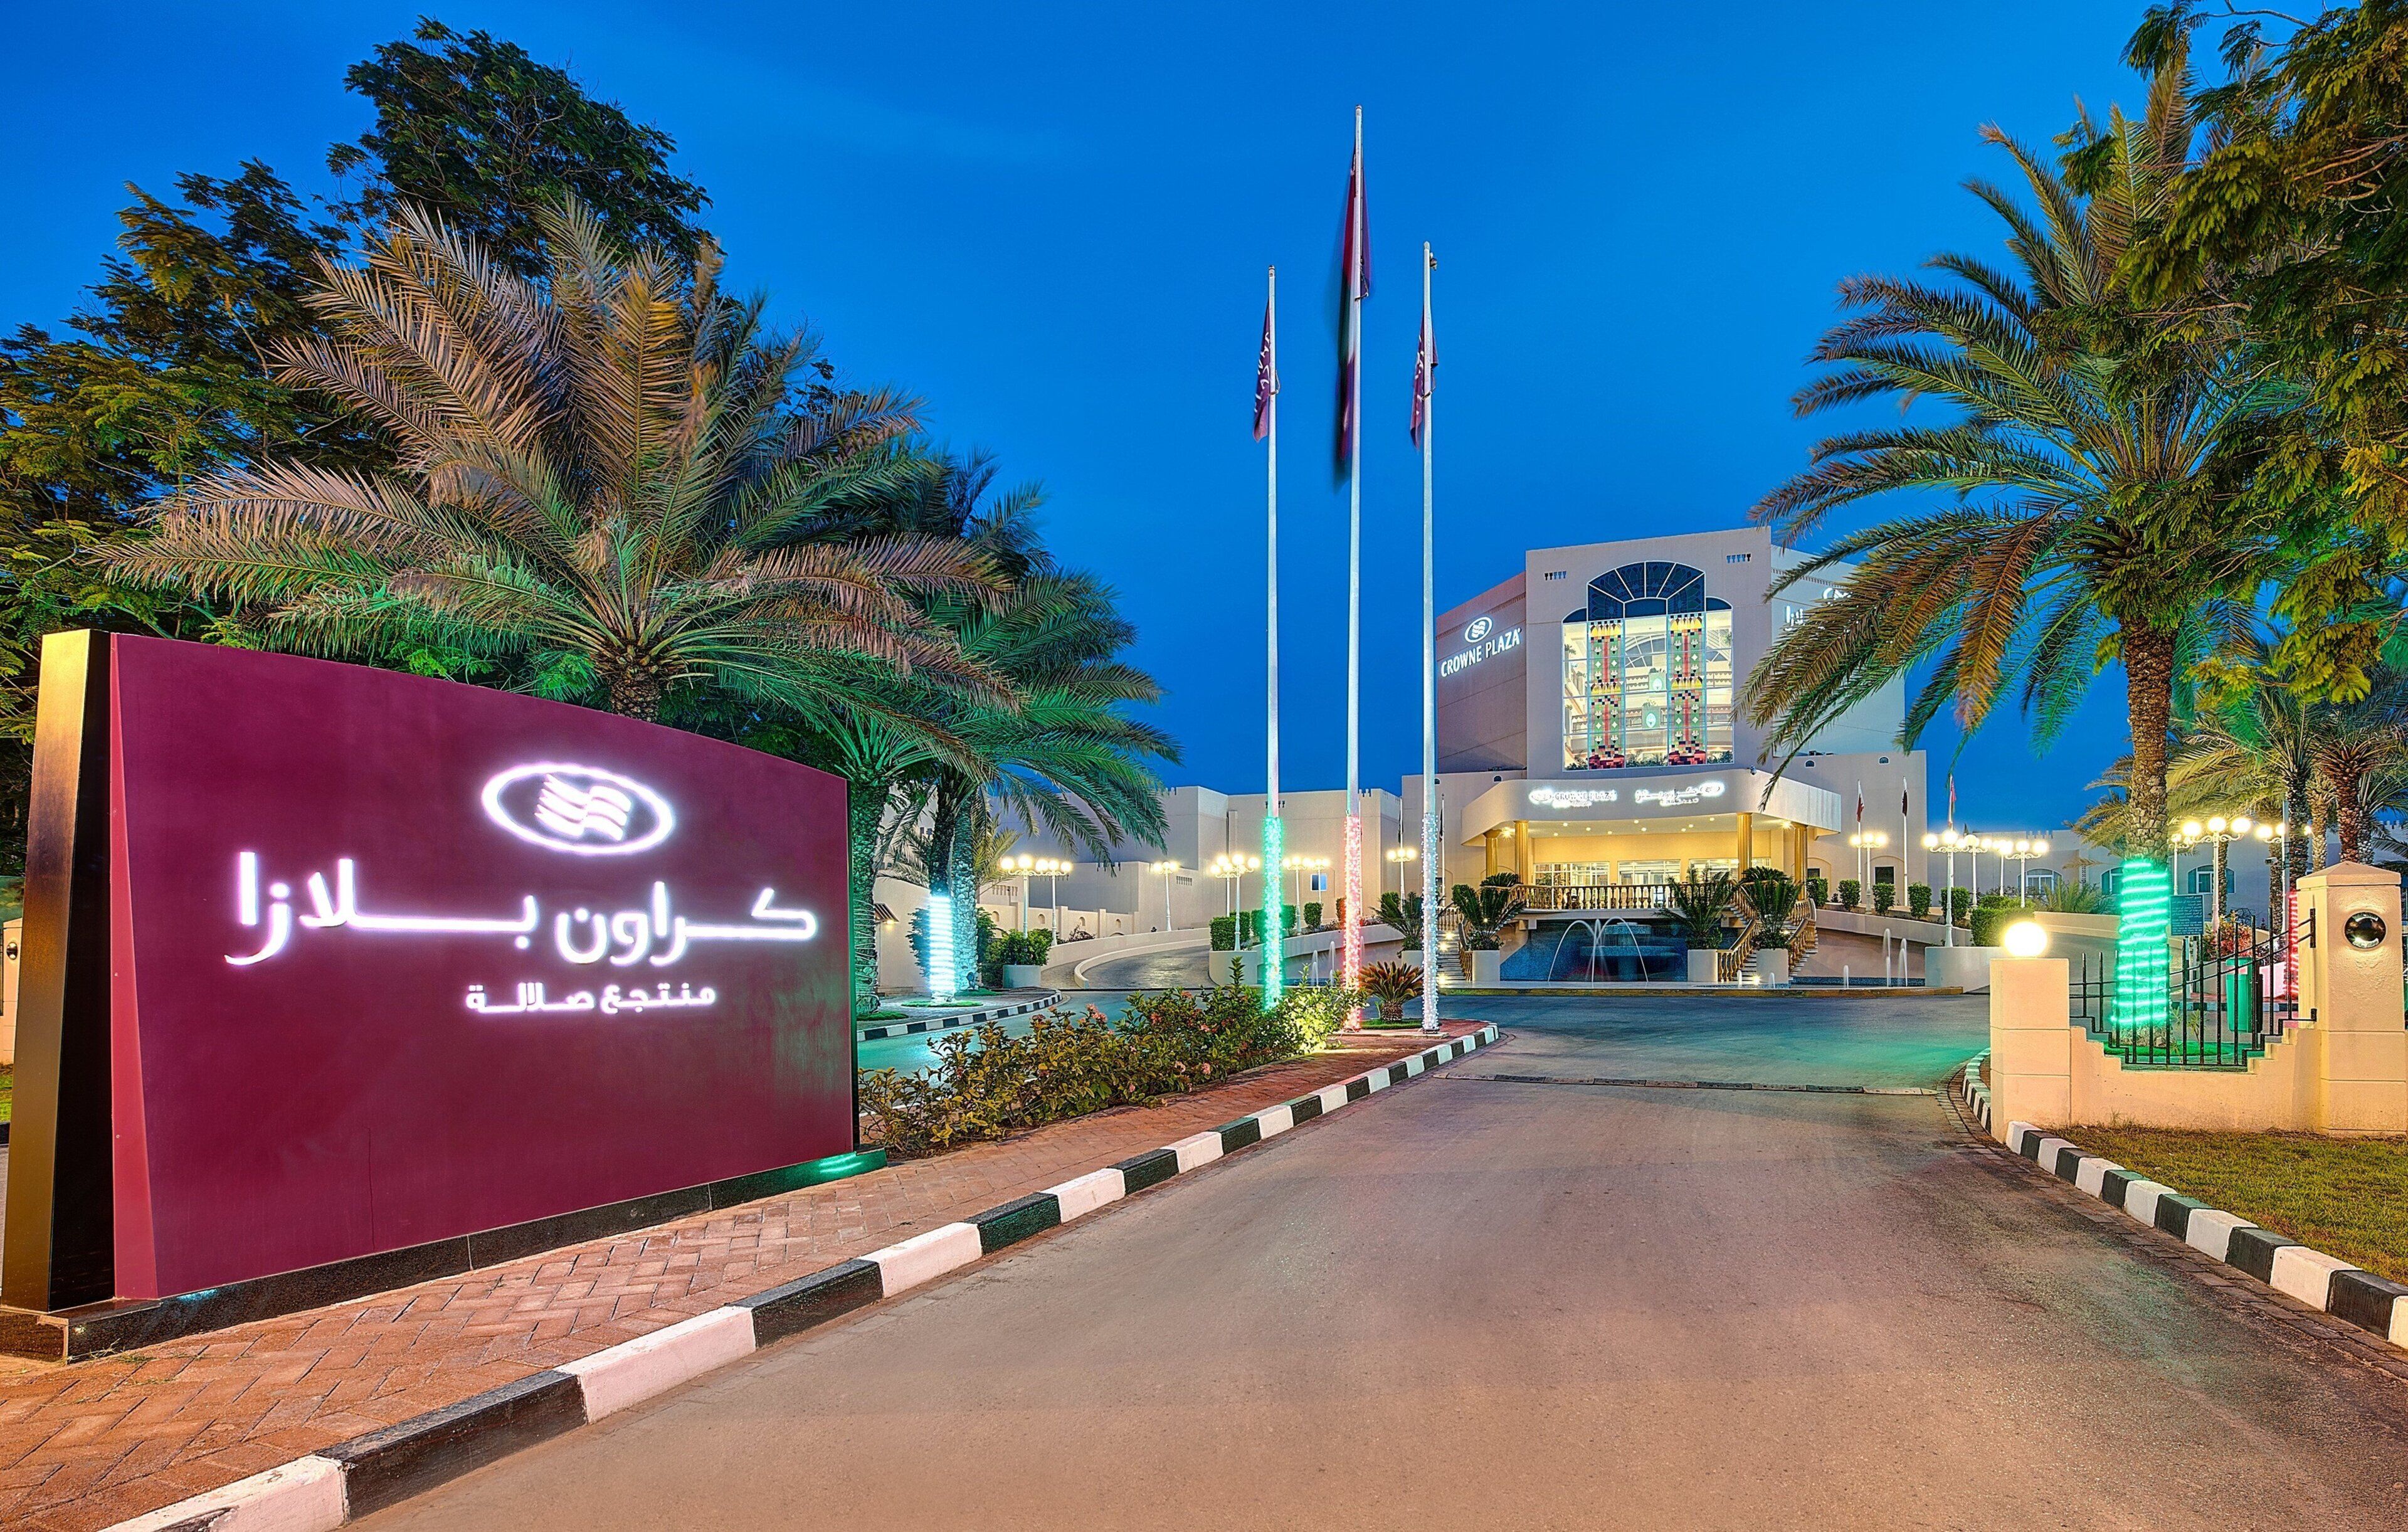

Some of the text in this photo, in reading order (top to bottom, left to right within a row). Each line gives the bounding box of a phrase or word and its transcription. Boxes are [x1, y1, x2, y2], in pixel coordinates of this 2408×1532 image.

[1440, 628, 1520, 677] CROWNE PLAZA
[224, 851, 817, 966] كراون بلازا
[465, 981, 716, 1015] منتجع صلالة
